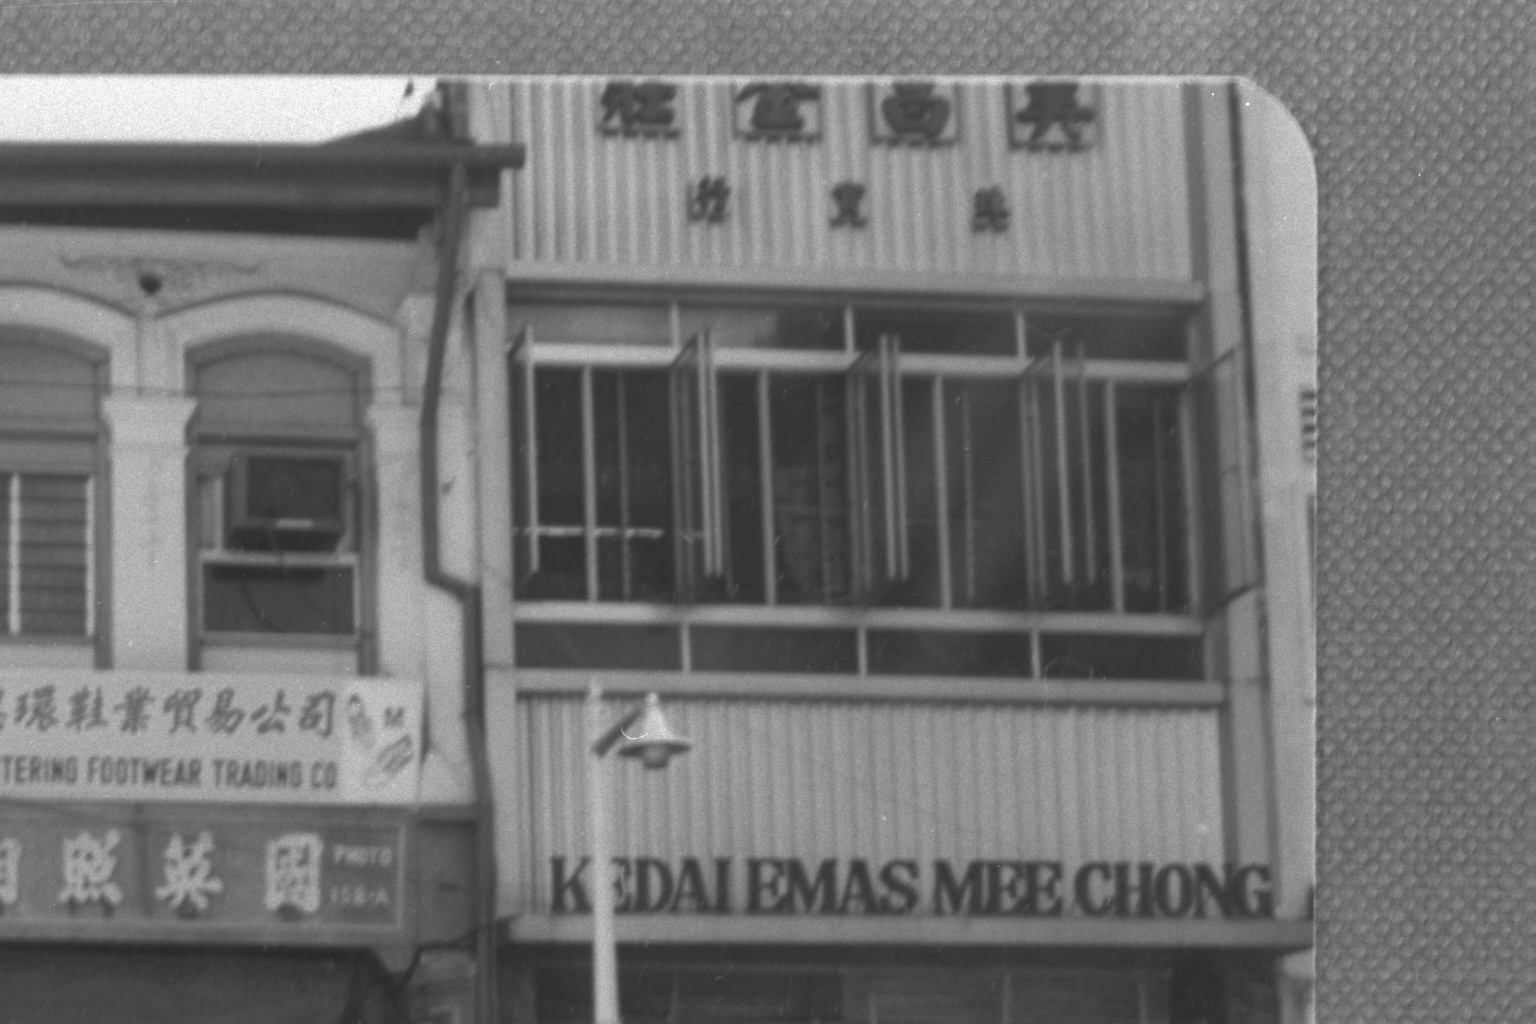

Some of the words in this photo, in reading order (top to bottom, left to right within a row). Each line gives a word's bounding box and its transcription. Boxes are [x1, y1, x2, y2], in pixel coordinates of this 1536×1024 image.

[87, 756, 202, 787] FOOTWEAR
[213, 759, 302, 789] TRADING
[310, 761, 338, 789] CO
[549, 856, 731, 915] KEDAI
[747, 857, 919, 916] EMAS
[932, 858, 1063, 917] MEE
[1073, 861, 1275, 920] CHONG
